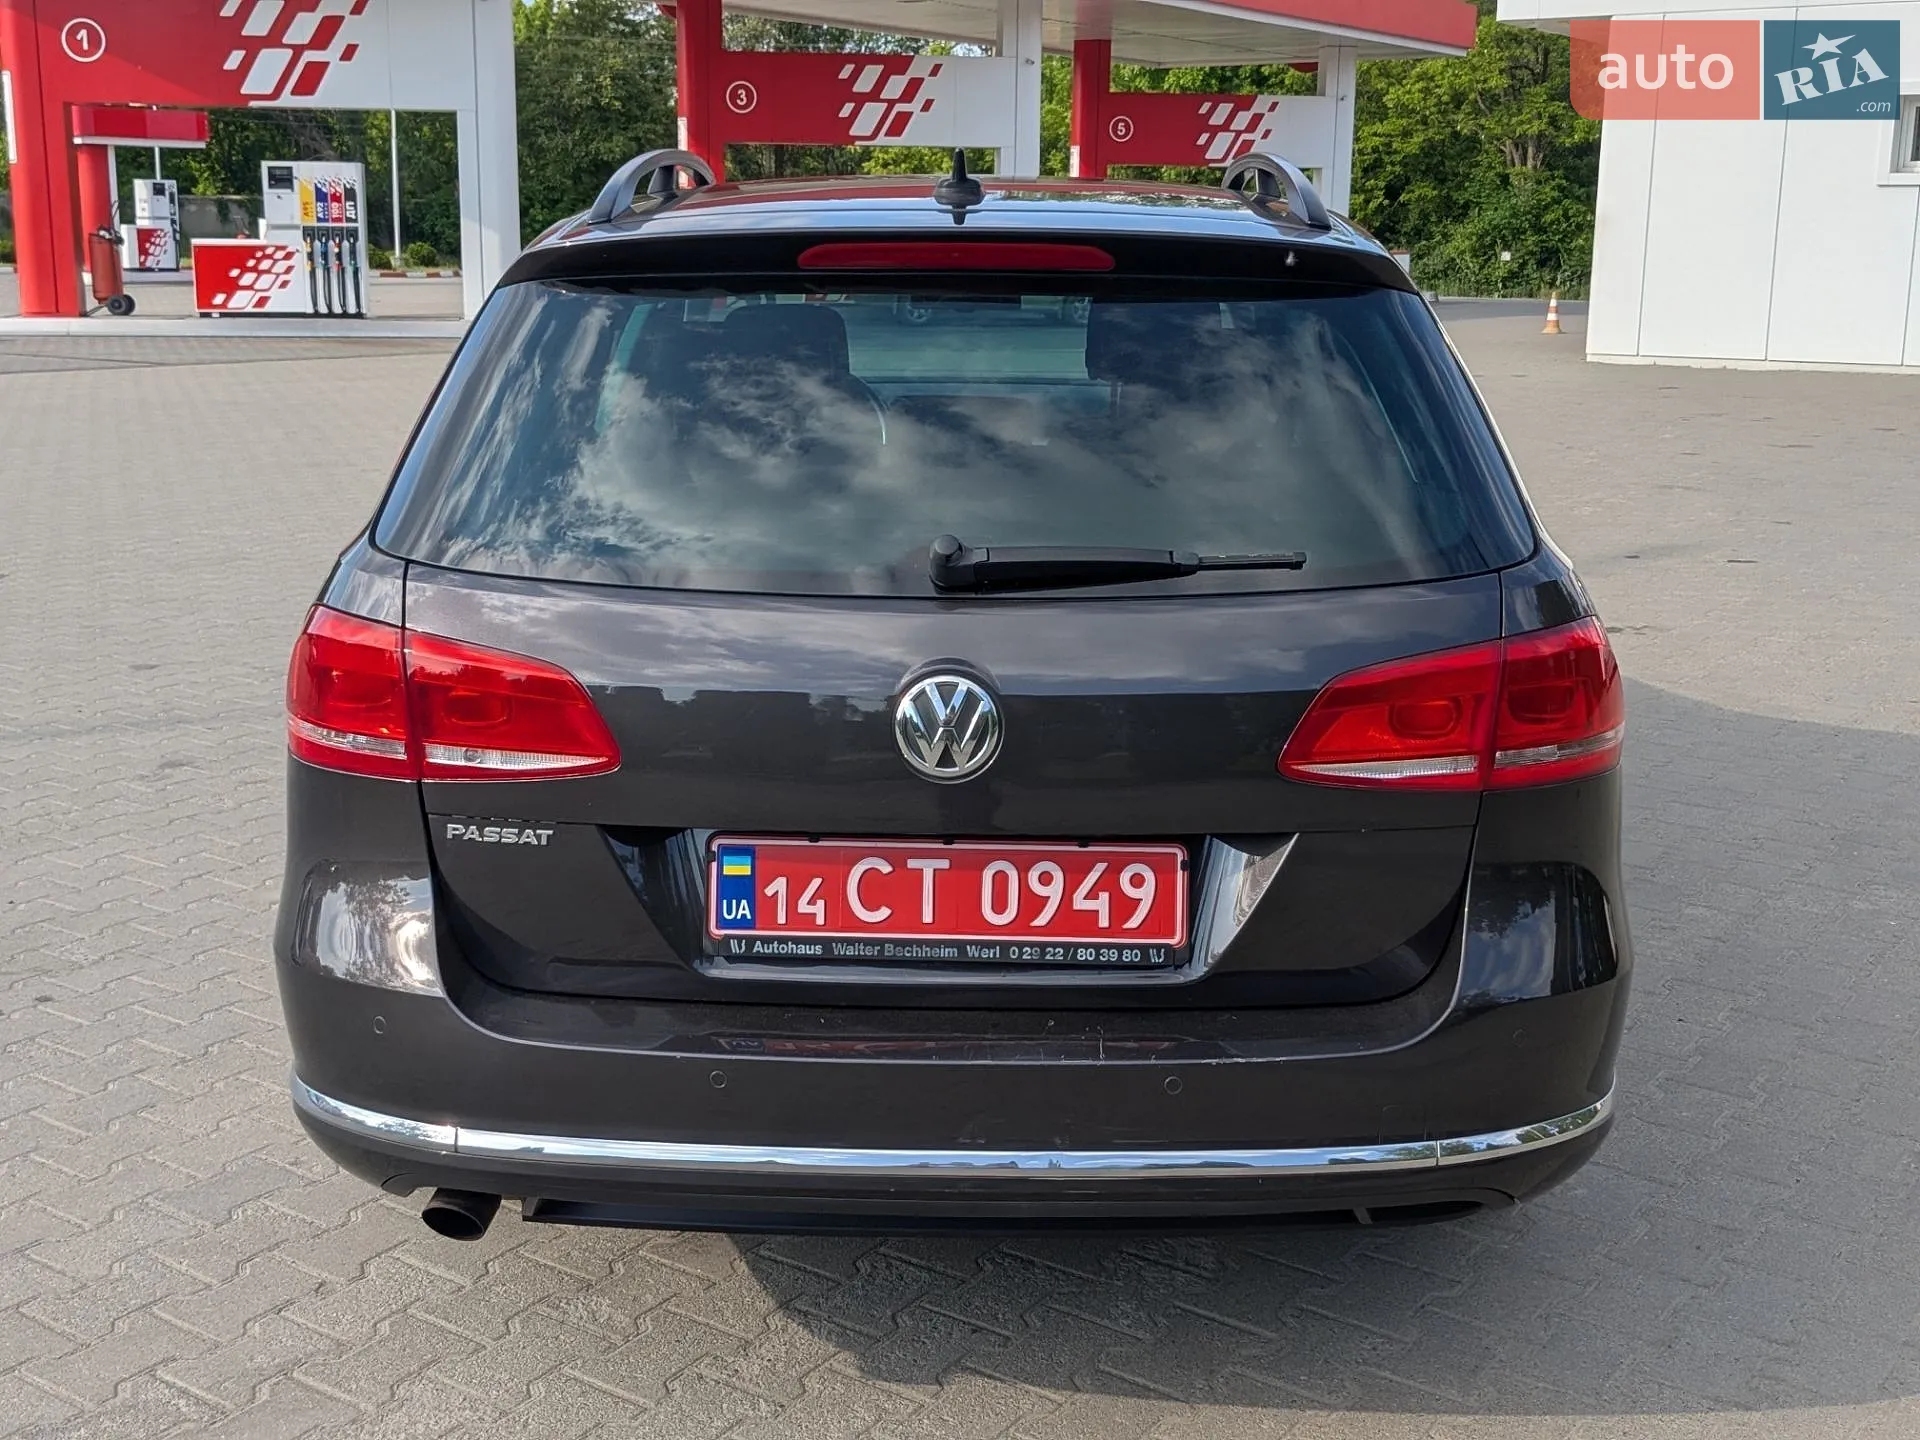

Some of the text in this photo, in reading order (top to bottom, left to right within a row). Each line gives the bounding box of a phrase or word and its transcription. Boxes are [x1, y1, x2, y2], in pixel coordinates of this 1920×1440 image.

[76, 28, 89, 51] 1
[736, 88, 748, 105] 3
[1116, 122, 1126, 136] 5
[446, 823, 554, 846] PASSAT
[763, 876, 825, 926] 14
[981, 859, 1157, 929] 0949
[722, 899, 751, 919] UA
[753, 940, 823, 956] Autohaus
[832, 942, 881, 957] Walter
[884, 943, 959, 958] Bechheim
